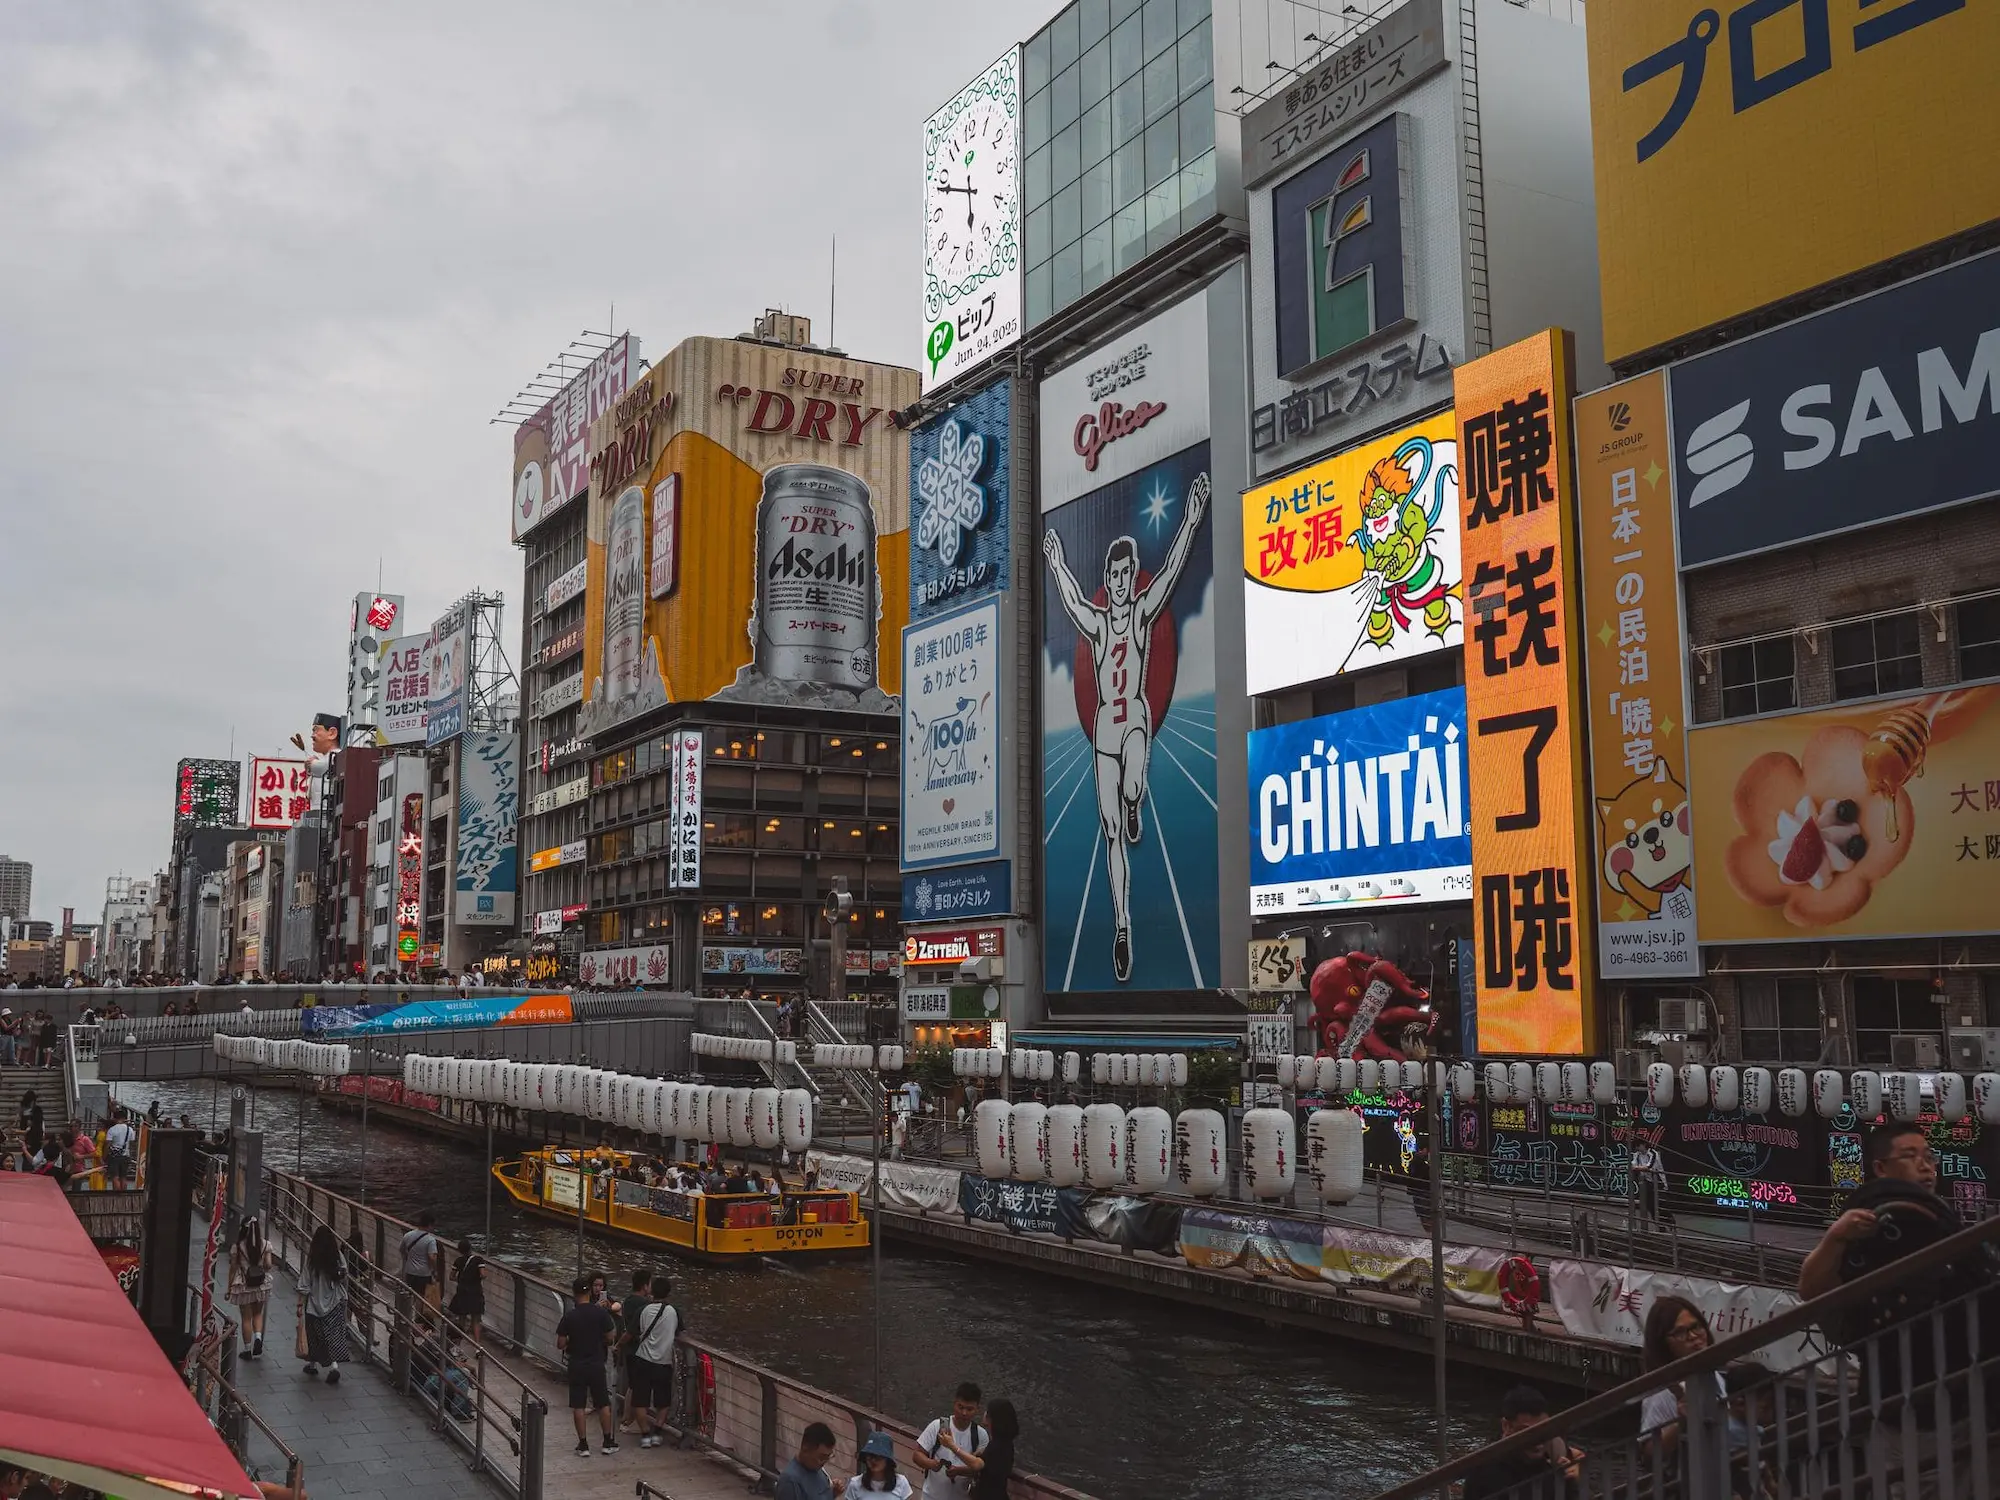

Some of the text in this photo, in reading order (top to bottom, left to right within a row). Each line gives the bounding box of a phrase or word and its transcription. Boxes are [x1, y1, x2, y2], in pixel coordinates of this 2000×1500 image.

[1284, 34, 1385, 117] 夢ある住まい
[1271, 53, 1406, 161] エステムシリーズ
[964, 118, 975, 143] 12
[992, 128, 1004, 150] 2
[938, 232, 948, 251] 8
[981, 221, 991, 242] 5
[950, 246, 960, 264] 7
[965, 241, 974, 262] 6
[958, 292, 997, 342] ピップ
[954, 348, 976, 367] Jun.
[992, 318, 1017, 344] 2025
[782, 367, 865, 397] SUPER
[1252, 333, 1451, 455] 日商エステム
[615, 379, 652, 429] SUPER
[1073, 401, 1168, 472] Glico
[1600, 443, 1610, 454] JS
[1612, 432, 1643, 450] GROUP
[801, 505, 837, 517] SUPER
[1266, 479, 1336, 524] かぜに
[652, 526, 673, 560] 1889
[1258, 505, 1344, 578] 改源
[768, 536, 865, 589] Asahi
[608, 555, 640, 613] Asahi
[916, 561, 988, 605] 雪印メグミルク
[805, 587, 830, 607] 生
[788, 619, 847, 635] スーパードライ
[913, 622, 988, 668] 創業100周年
[387, 647, 420, 675] 入店
[922, 658, 978, 695] ありがとう
[1109, 635, 1129, 725] グリコ
[1463, 388, 1574, 992] 赚钱了哦
[259, 765, 310, 792] かに
[684, 755, 697, 806] 本場の味
[923, 770, 978, 792] Anniversary
[1259, 715, 1463, 864] CHINTAI
[258, 796, 311, 820] 道楽
[917, 818, 981, 837] MEGMILK SNOW BRAND
[682, 811, 698, 883] かに道楽
[934, 888, 991, 911] 雪印メグミルク
[1256, 892, 1285, 908] 天気予報
[466, 913, 506, 921] 文化シャッター
[918, 941, 971, 959] ZETTERIA
[1610, 929, 1686, 947] www.jsv.jp
[1610, 950, 1688, 965] 06-4963-3661
[1681, 1122, 1745, 1143] UNIVERSAL
[1745, 1124, 1800, 1149] STUDIOS
[1721, 1141, 1757, 1154] JAPAN
[776, 1227, 823, 1240] DOTON
